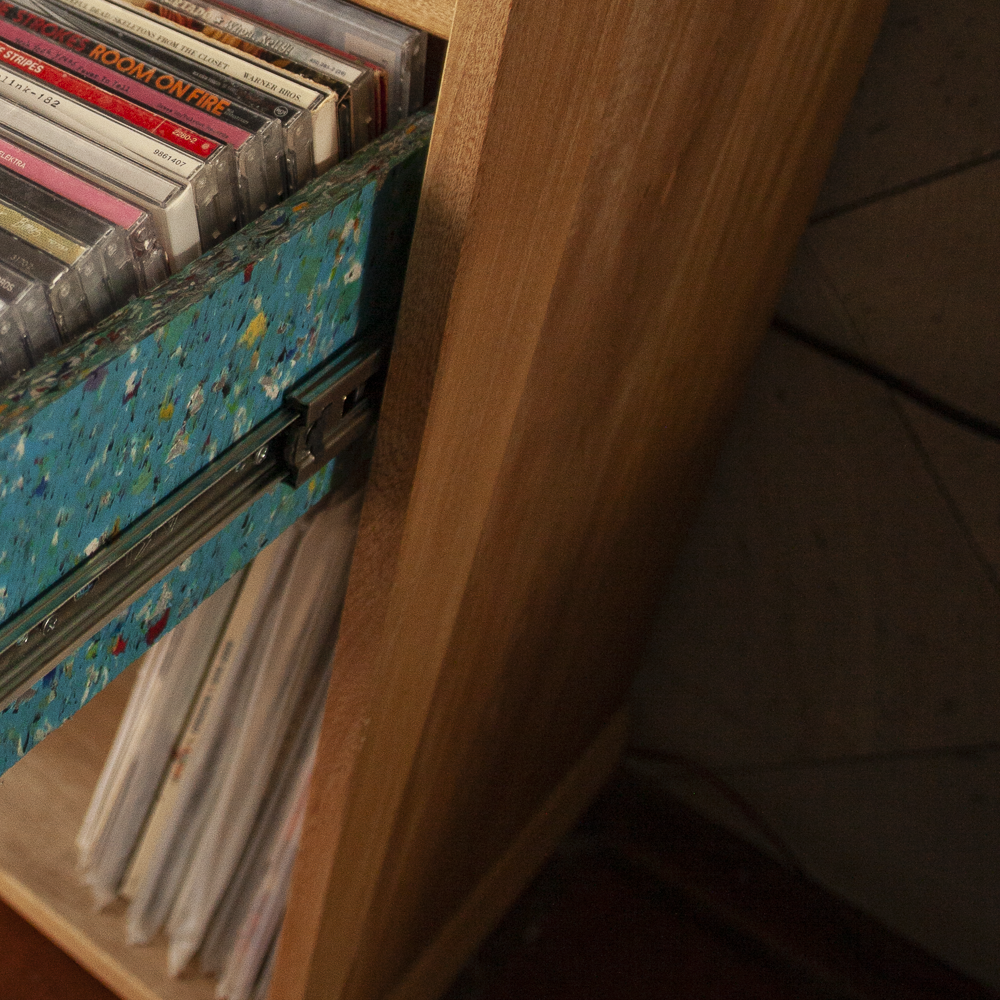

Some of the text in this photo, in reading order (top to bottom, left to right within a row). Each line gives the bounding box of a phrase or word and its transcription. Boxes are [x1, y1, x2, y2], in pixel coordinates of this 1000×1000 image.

[2, 49, 45, 74] STRIPES
[10, 9, 91, 52] STROKES
[87, 43, 157, 82] ROOM
[153, 72, 192, 98] ON
[184, 86, 232, 116] FIRE
[155, 35, 179, 49] FROM
[179, 45, 196, 56] THE
[196, 52, 230, 70] CLOSET
[241, 71, 279, 91] WARNER
[277, 87, 302, 102] BROS.
[152, 148, 186, 168] 9861407
